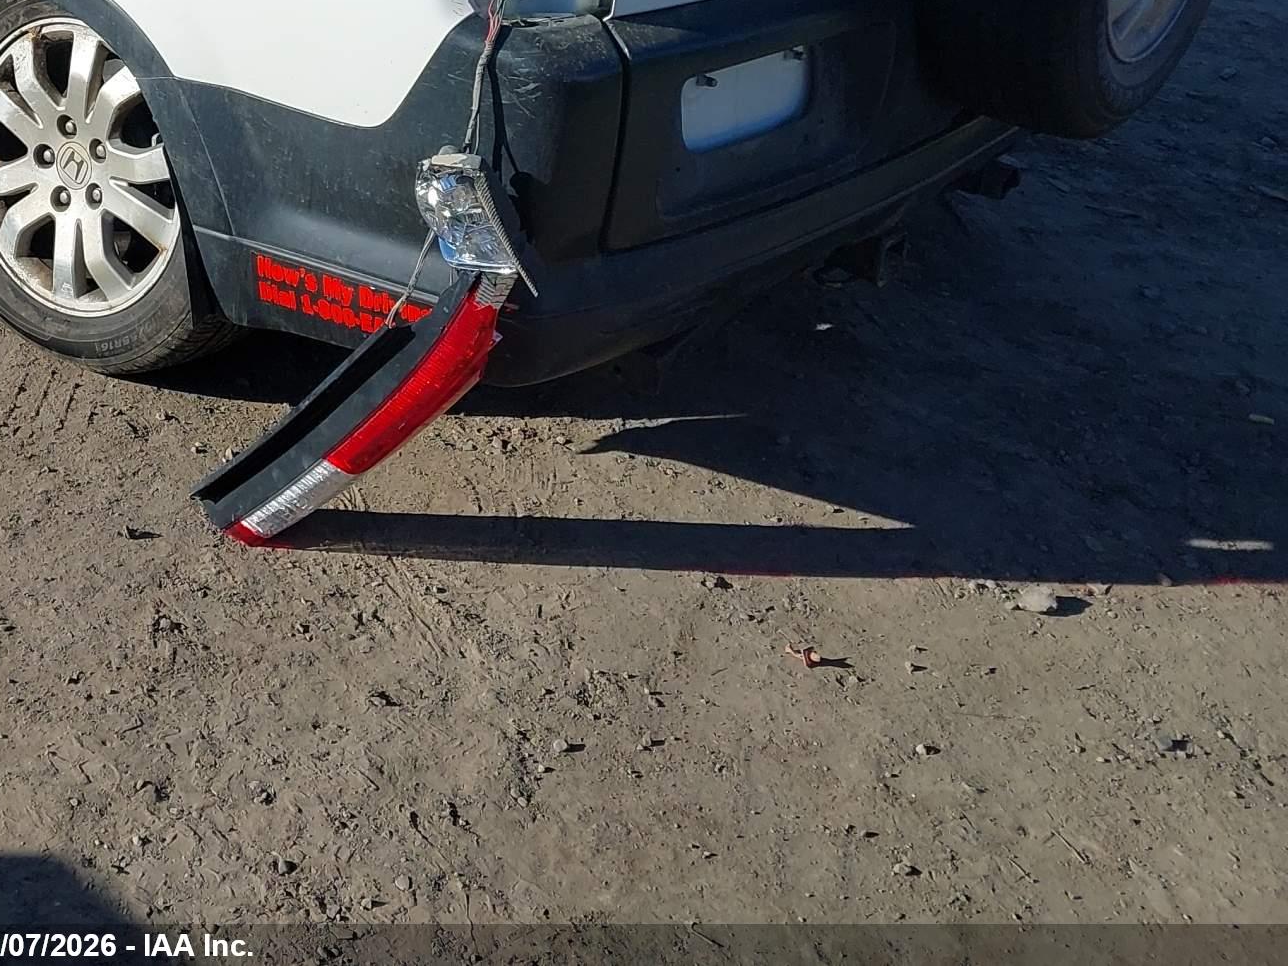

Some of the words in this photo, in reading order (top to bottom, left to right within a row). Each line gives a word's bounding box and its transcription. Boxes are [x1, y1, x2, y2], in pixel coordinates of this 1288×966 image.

[257, 253, 318, 293] How's
[322, 274, 354, 307] My
[258, 281, 297, 312] Dial
